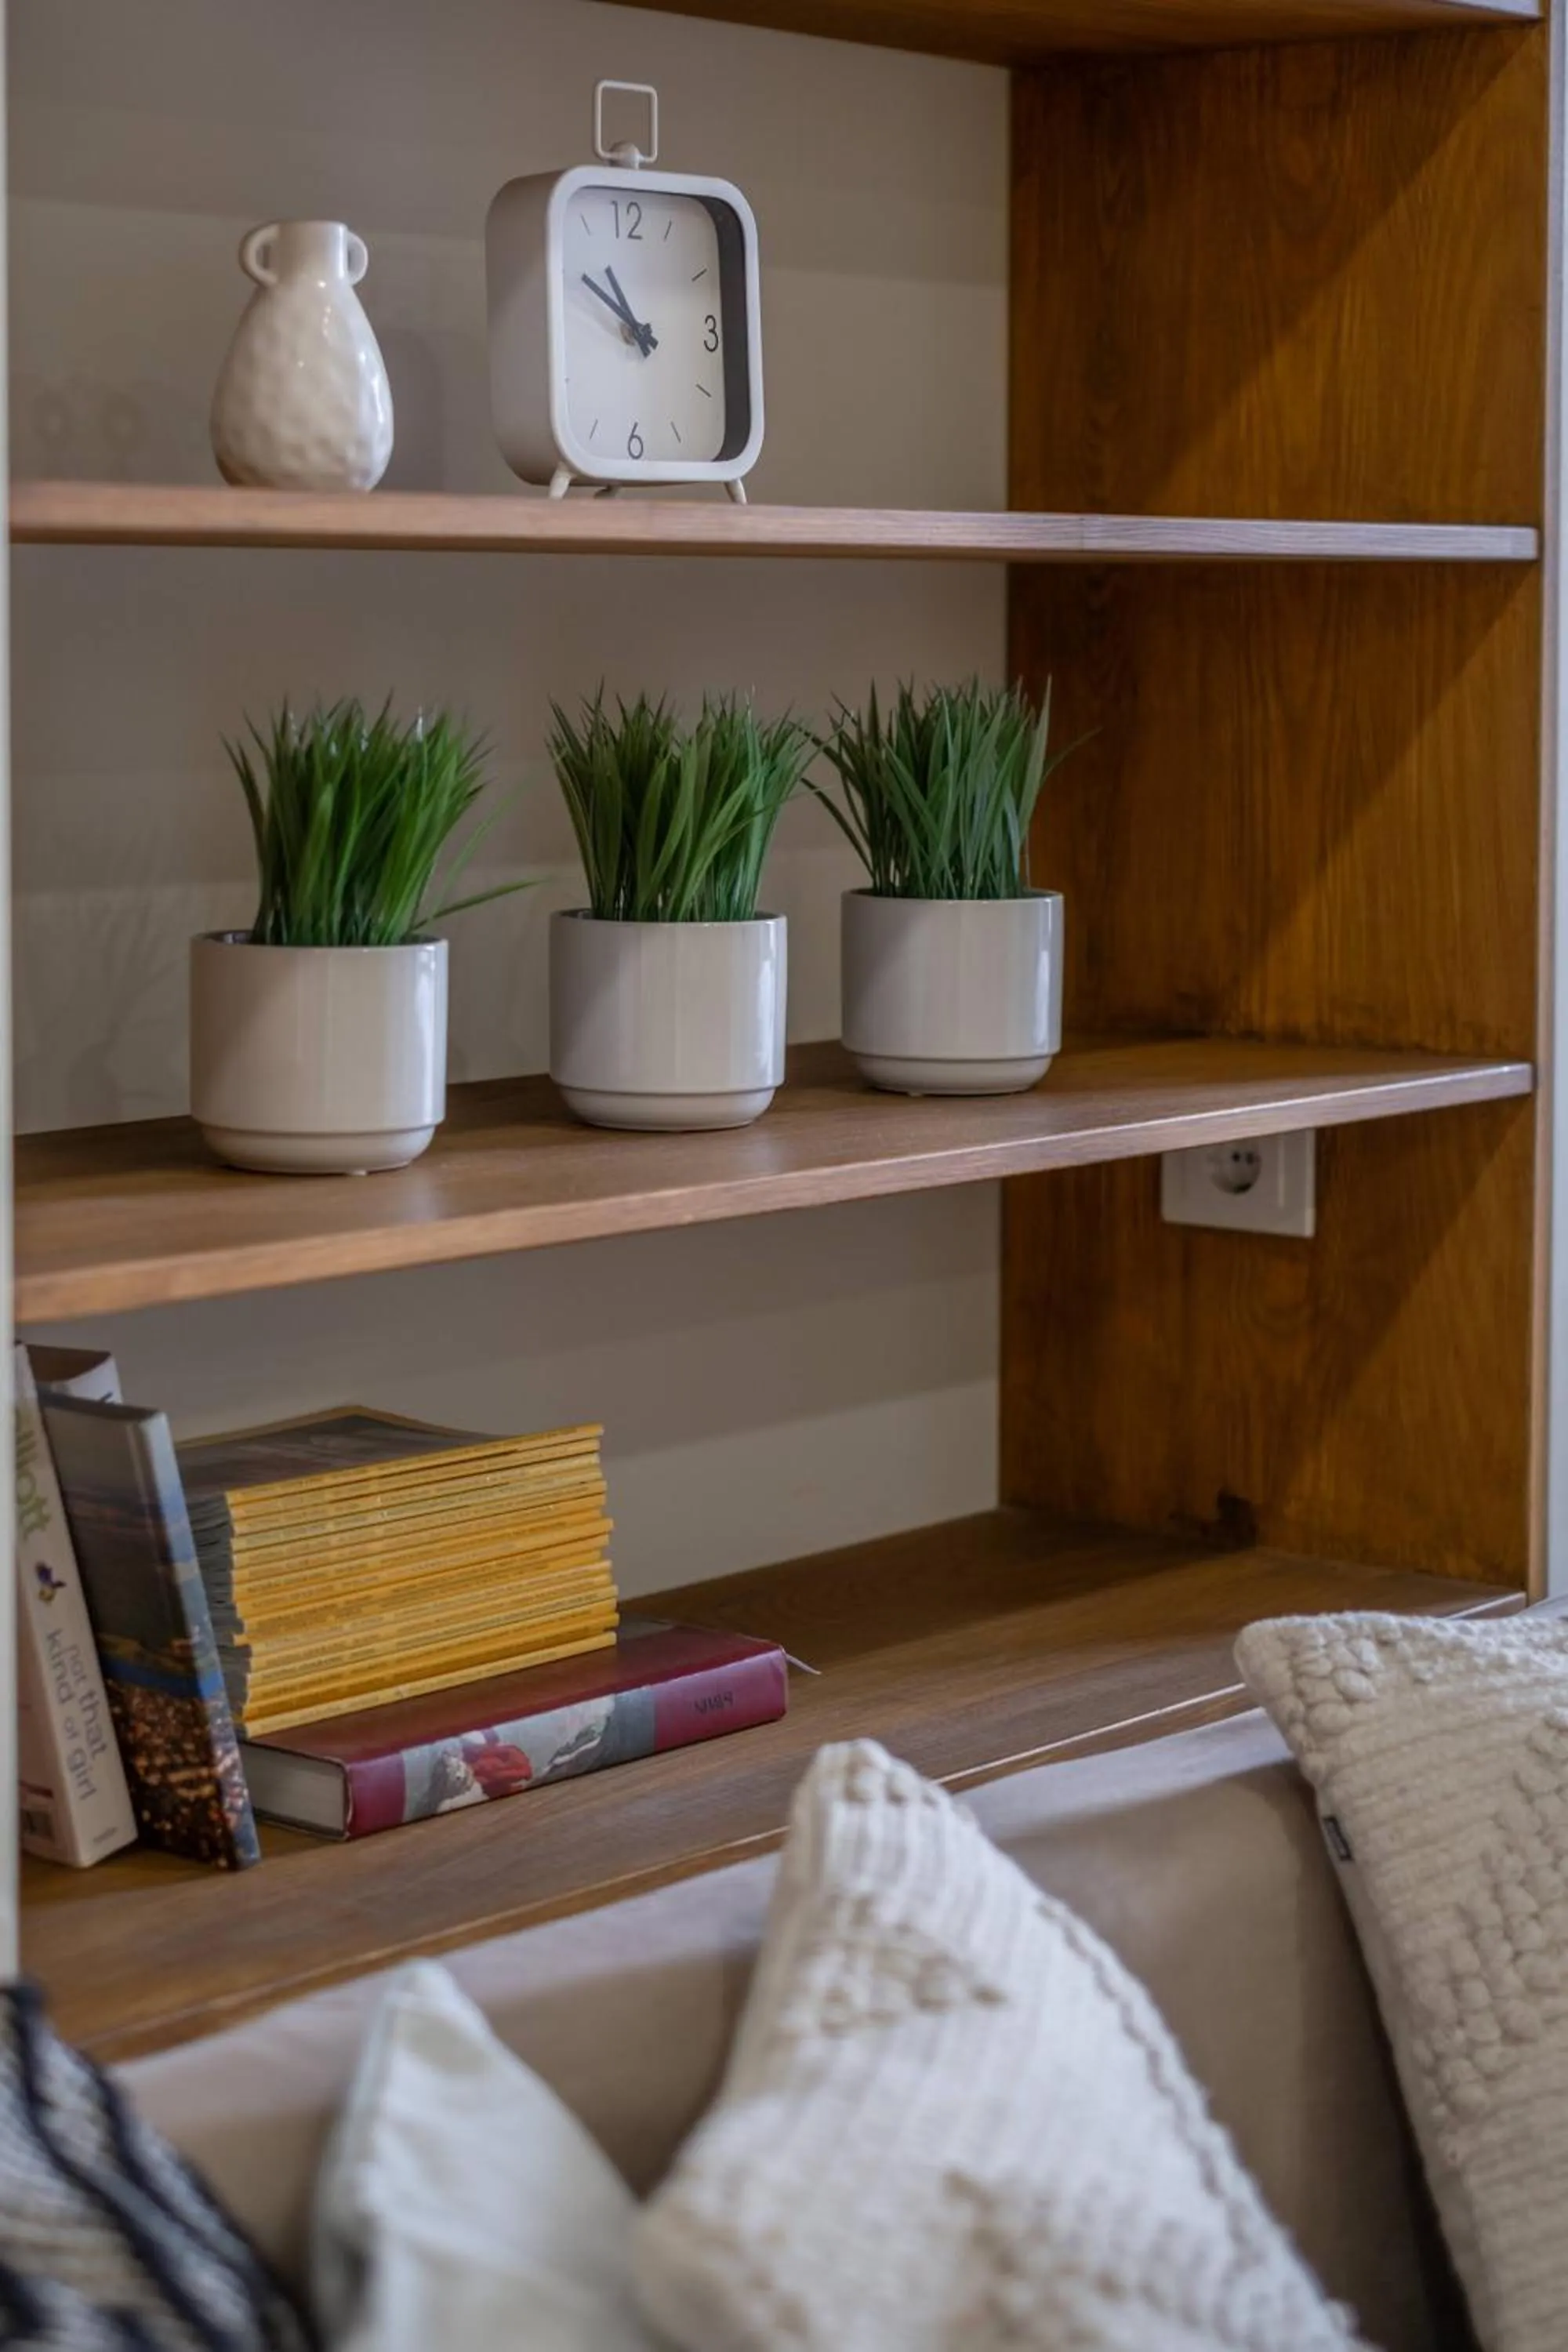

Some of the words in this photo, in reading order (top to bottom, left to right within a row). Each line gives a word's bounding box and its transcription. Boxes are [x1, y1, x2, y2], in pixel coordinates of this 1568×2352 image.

[611, 201, 643, 240] 12
[703, 314, 719, 352] 3
[627, 422, 644, 459] 6
[16, 1409, 52, 1541] lliott
[47, 1628, 75, 1704] kind
[67, 1747, 98, 1801] girl
[68, 1643, 87, 1683] not
[78, 1689, 107, 1760] that
